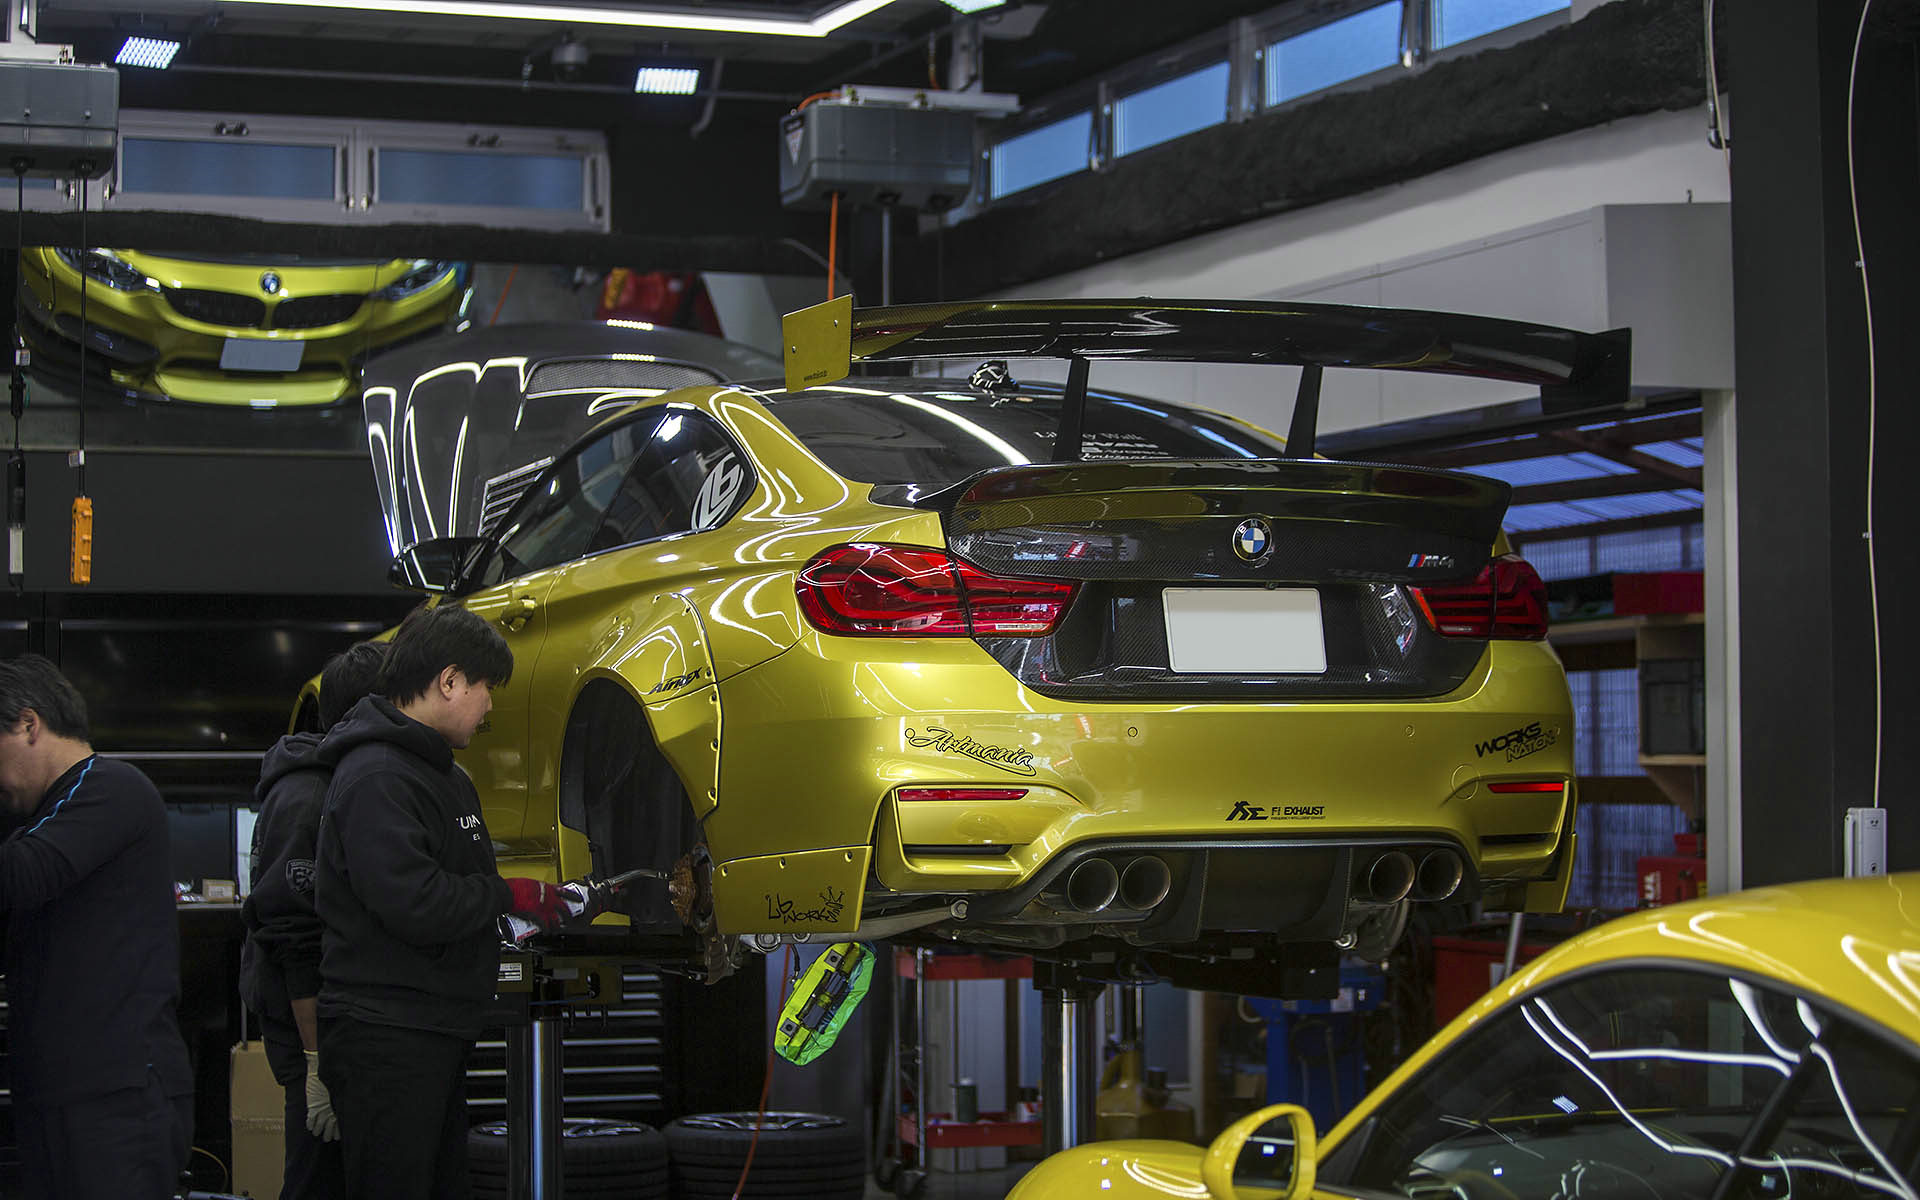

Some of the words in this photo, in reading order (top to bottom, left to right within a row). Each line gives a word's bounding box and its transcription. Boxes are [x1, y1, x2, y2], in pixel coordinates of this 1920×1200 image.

[904, 726, 1037, 777] Artmania
[1475, 721, 1542, 758] WORKS
[1284, 806, 1325, 816] EXHAUST
